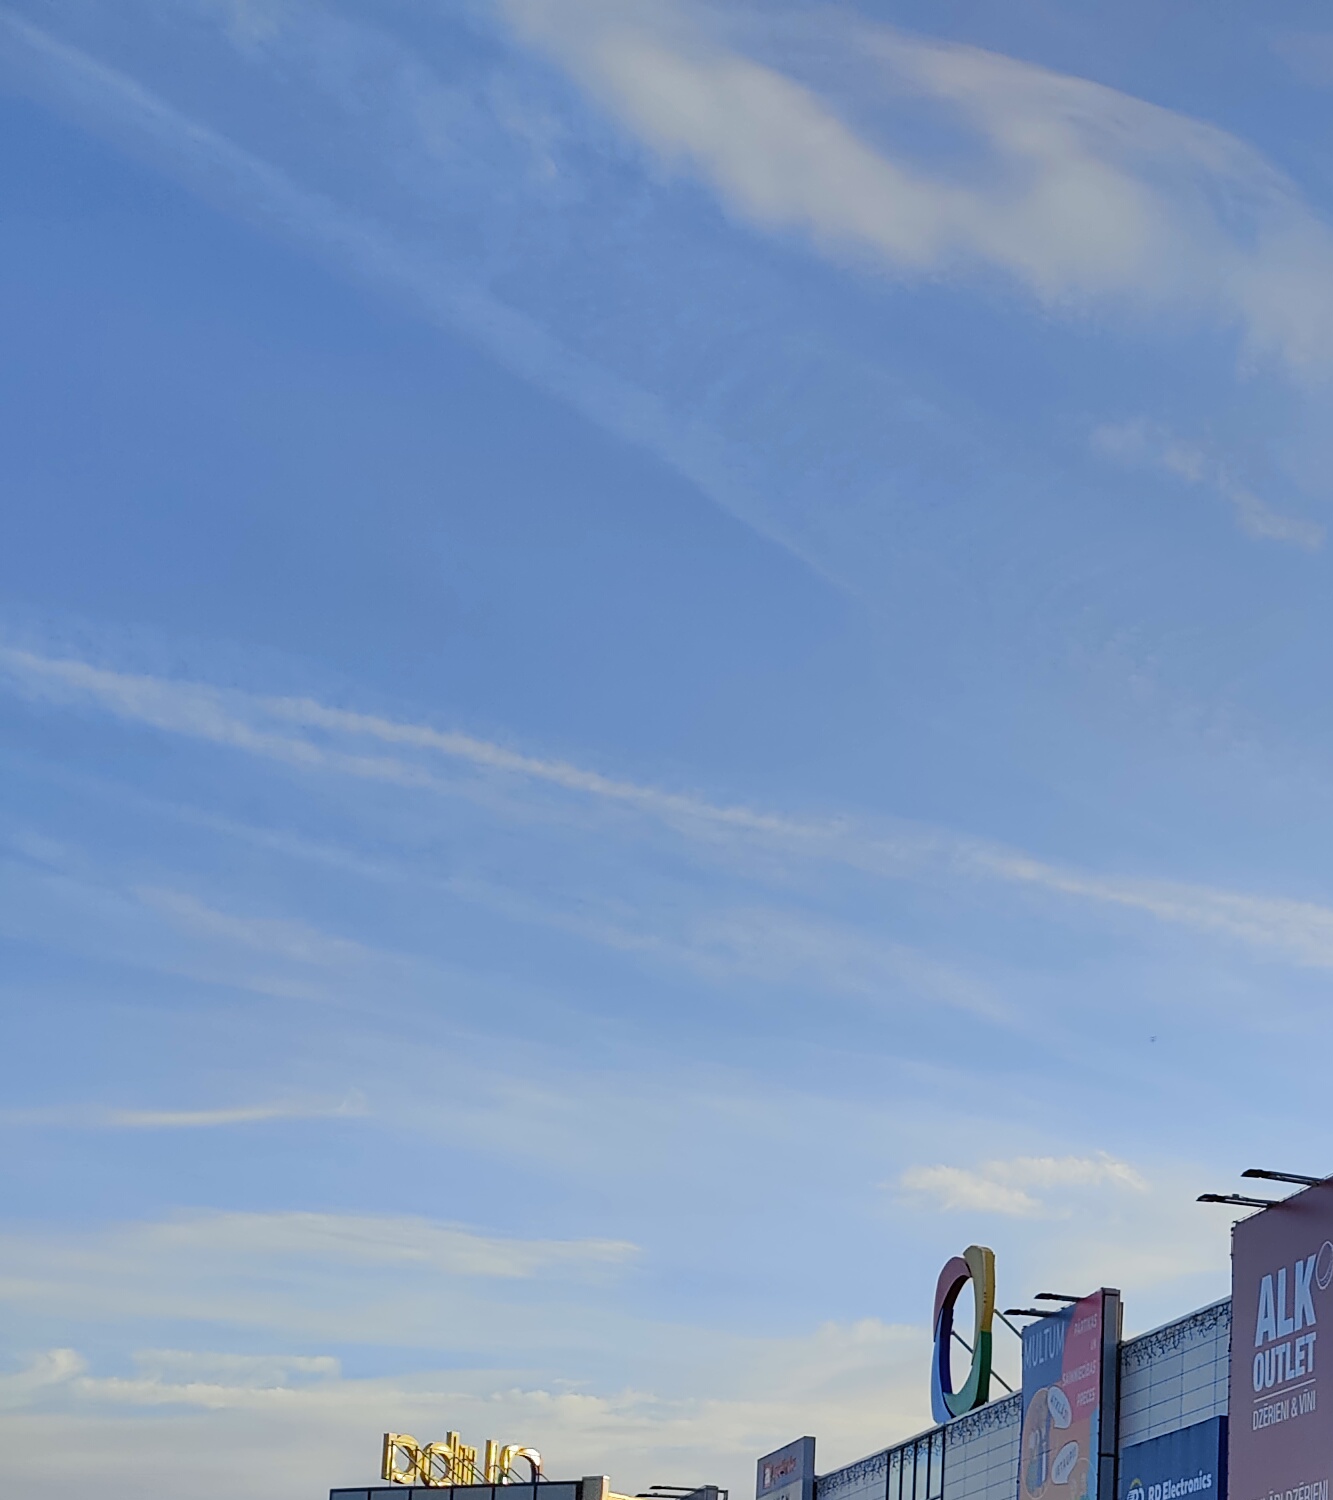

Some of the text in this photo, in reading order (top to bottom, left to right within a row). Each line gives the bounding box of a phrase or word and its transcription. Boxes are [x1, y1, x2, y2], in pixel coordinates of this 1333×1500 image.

[1255, 1254, 1317, 1347] ALK
[1023, 1321, 1065, 1370] MULTUM
[1253, 1332, 1317, 1392] OUTLET
[1253, 1389, 1316, 1430] DZĒRIENI & VĪNI
[1162, 1470, 1212, 1500] Electronics
